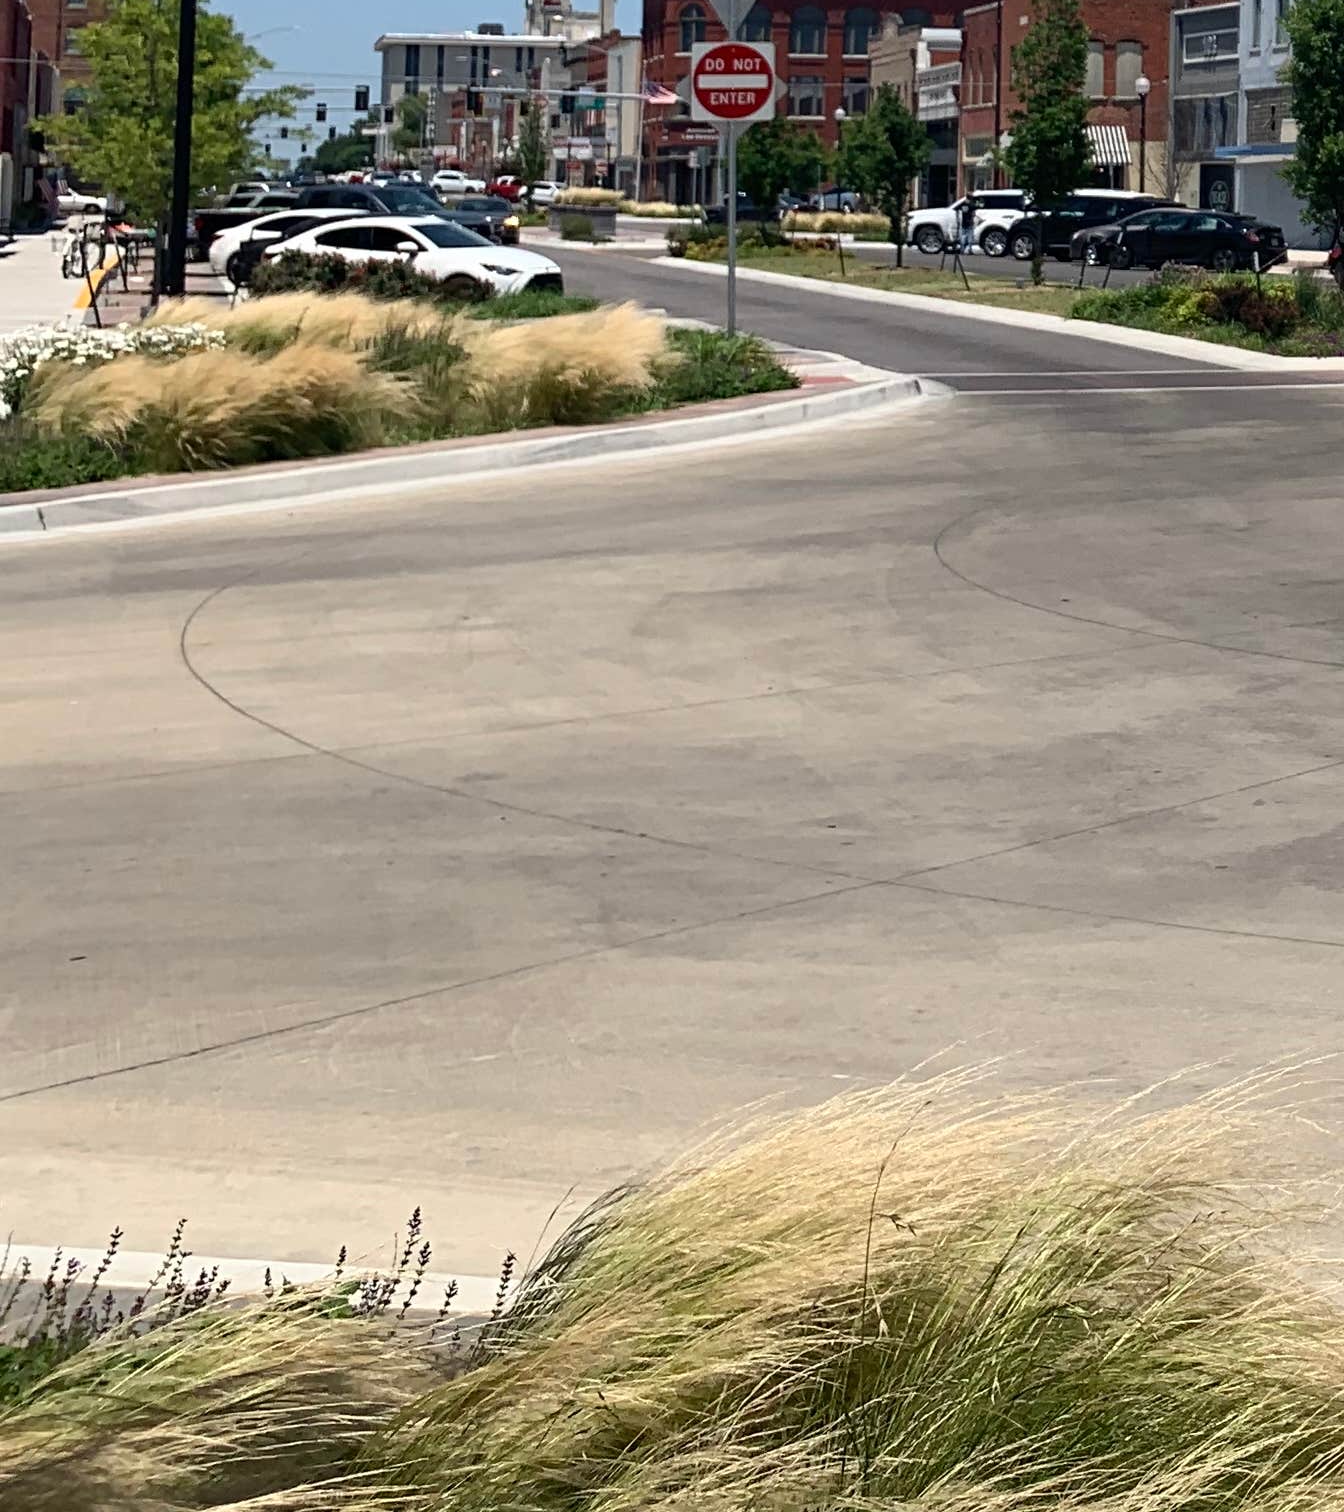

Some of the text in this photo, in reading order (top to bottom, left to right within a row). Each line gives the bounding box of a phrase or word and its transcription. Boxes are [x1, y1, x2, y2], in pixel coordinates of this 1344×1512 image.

[705, 58, 761, 72] DO NOT
[709, 91, 756, 105] ENTER
